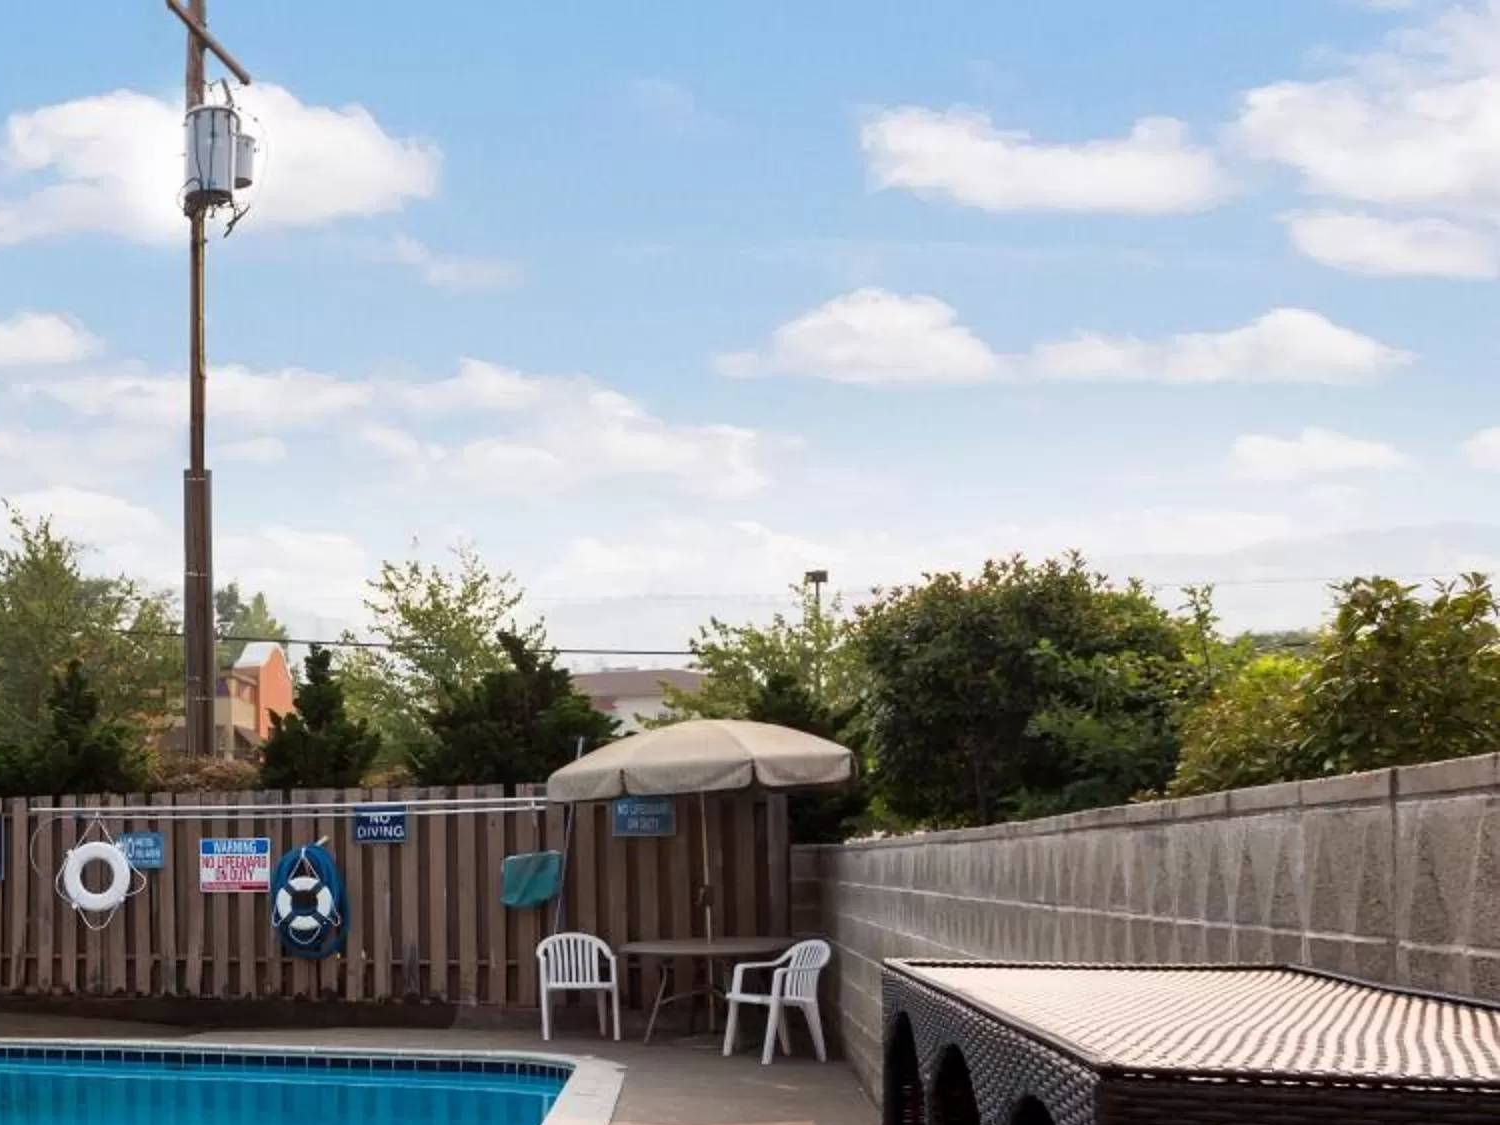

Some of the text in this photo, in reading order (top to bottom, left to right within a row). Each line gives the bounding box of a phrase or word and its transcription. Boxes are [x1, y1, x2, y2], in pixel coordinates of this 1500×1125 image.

[357, 825, 404, 839] DIVING
[213, 840, 257, 854] WARNING
[201, 856, 267, 869] NO LIFEGUARD
[215, 869, 254, 881] ON DUTY
